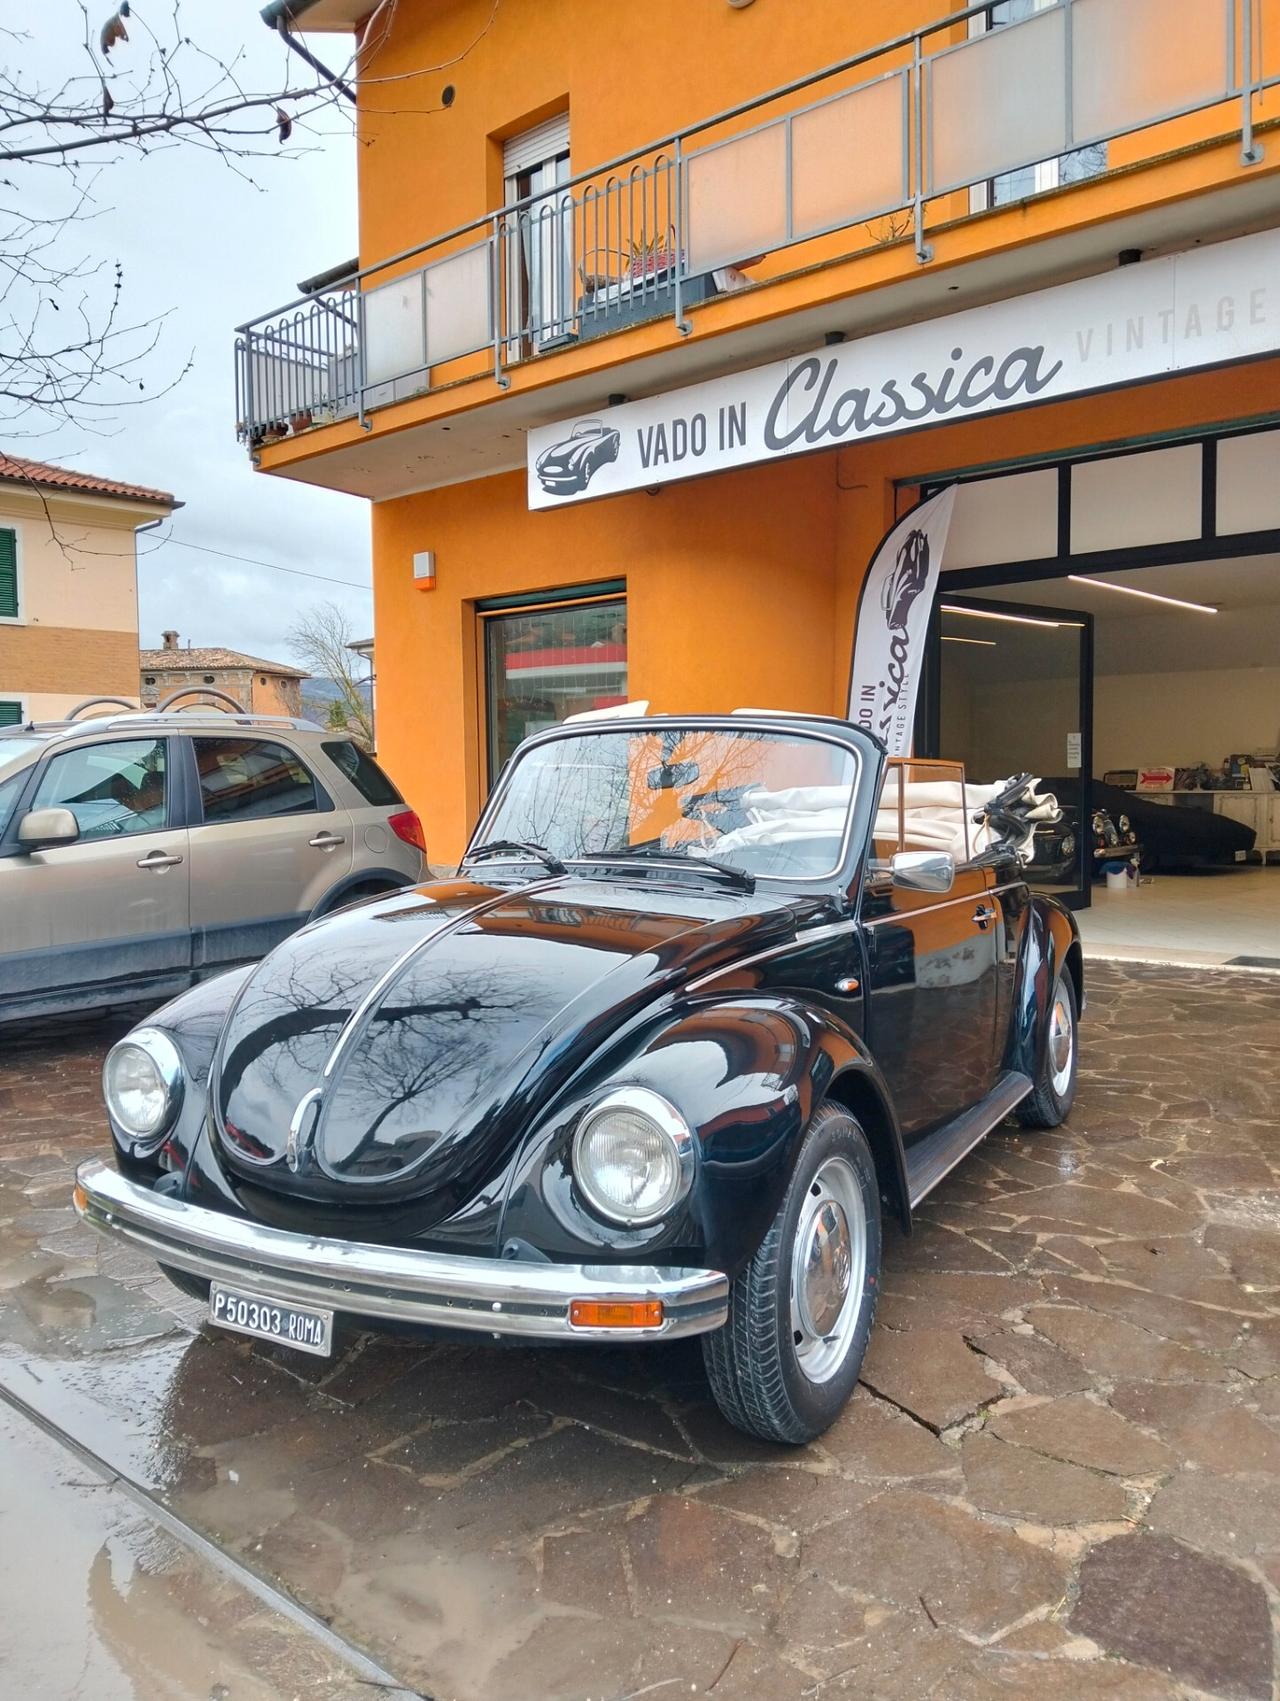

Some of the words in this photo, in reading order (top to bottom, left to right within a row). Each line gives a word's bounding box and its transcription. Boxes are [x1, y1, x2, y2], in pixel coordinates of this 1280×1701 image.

[637, 413, 706, 468] VADO
[719, 401, 747, 450] IN
[764, 345, 1063, 451] Classica
[1076, 288, 1266, 362] VINTAGE
[861, 685, 876, 701] IN
[215, 1293, 281, 1334] P50303
[288, 1314, 321, 1344] ROMA
